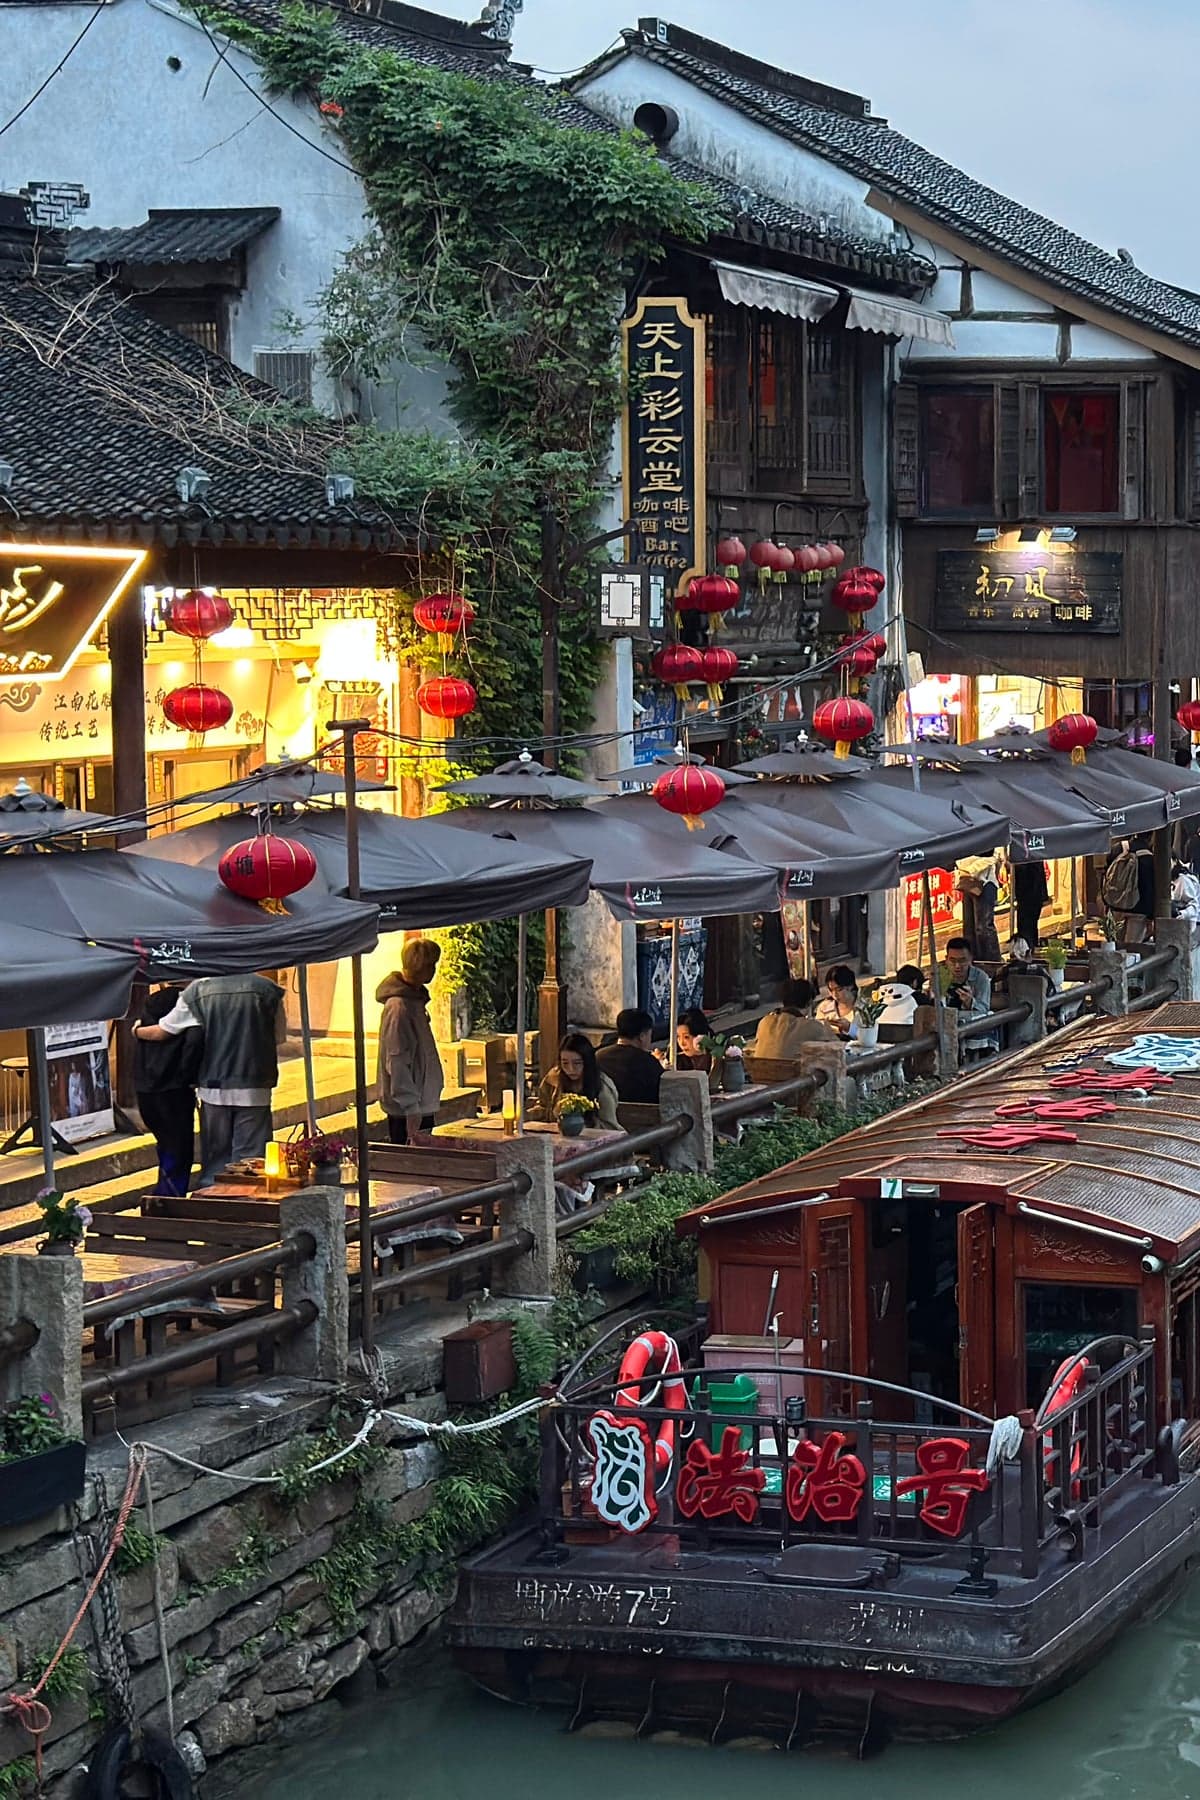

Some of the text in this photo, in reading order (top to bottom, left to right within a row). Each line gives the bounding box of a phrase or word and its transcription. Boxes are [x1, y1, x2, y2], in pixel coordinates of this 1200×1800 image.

[637, 322, 684, 494] 天上彩云堂
[633, 497, 690, 513] 咖啡
[645, 537, 679, 552] Bar
[975, 564, 1060, 604] 初见
[1055, 605, 1093, 621] 咖啡
[886, 1177, 898, 1199] 7
[677, 1426, 988, 1538] 法治号
